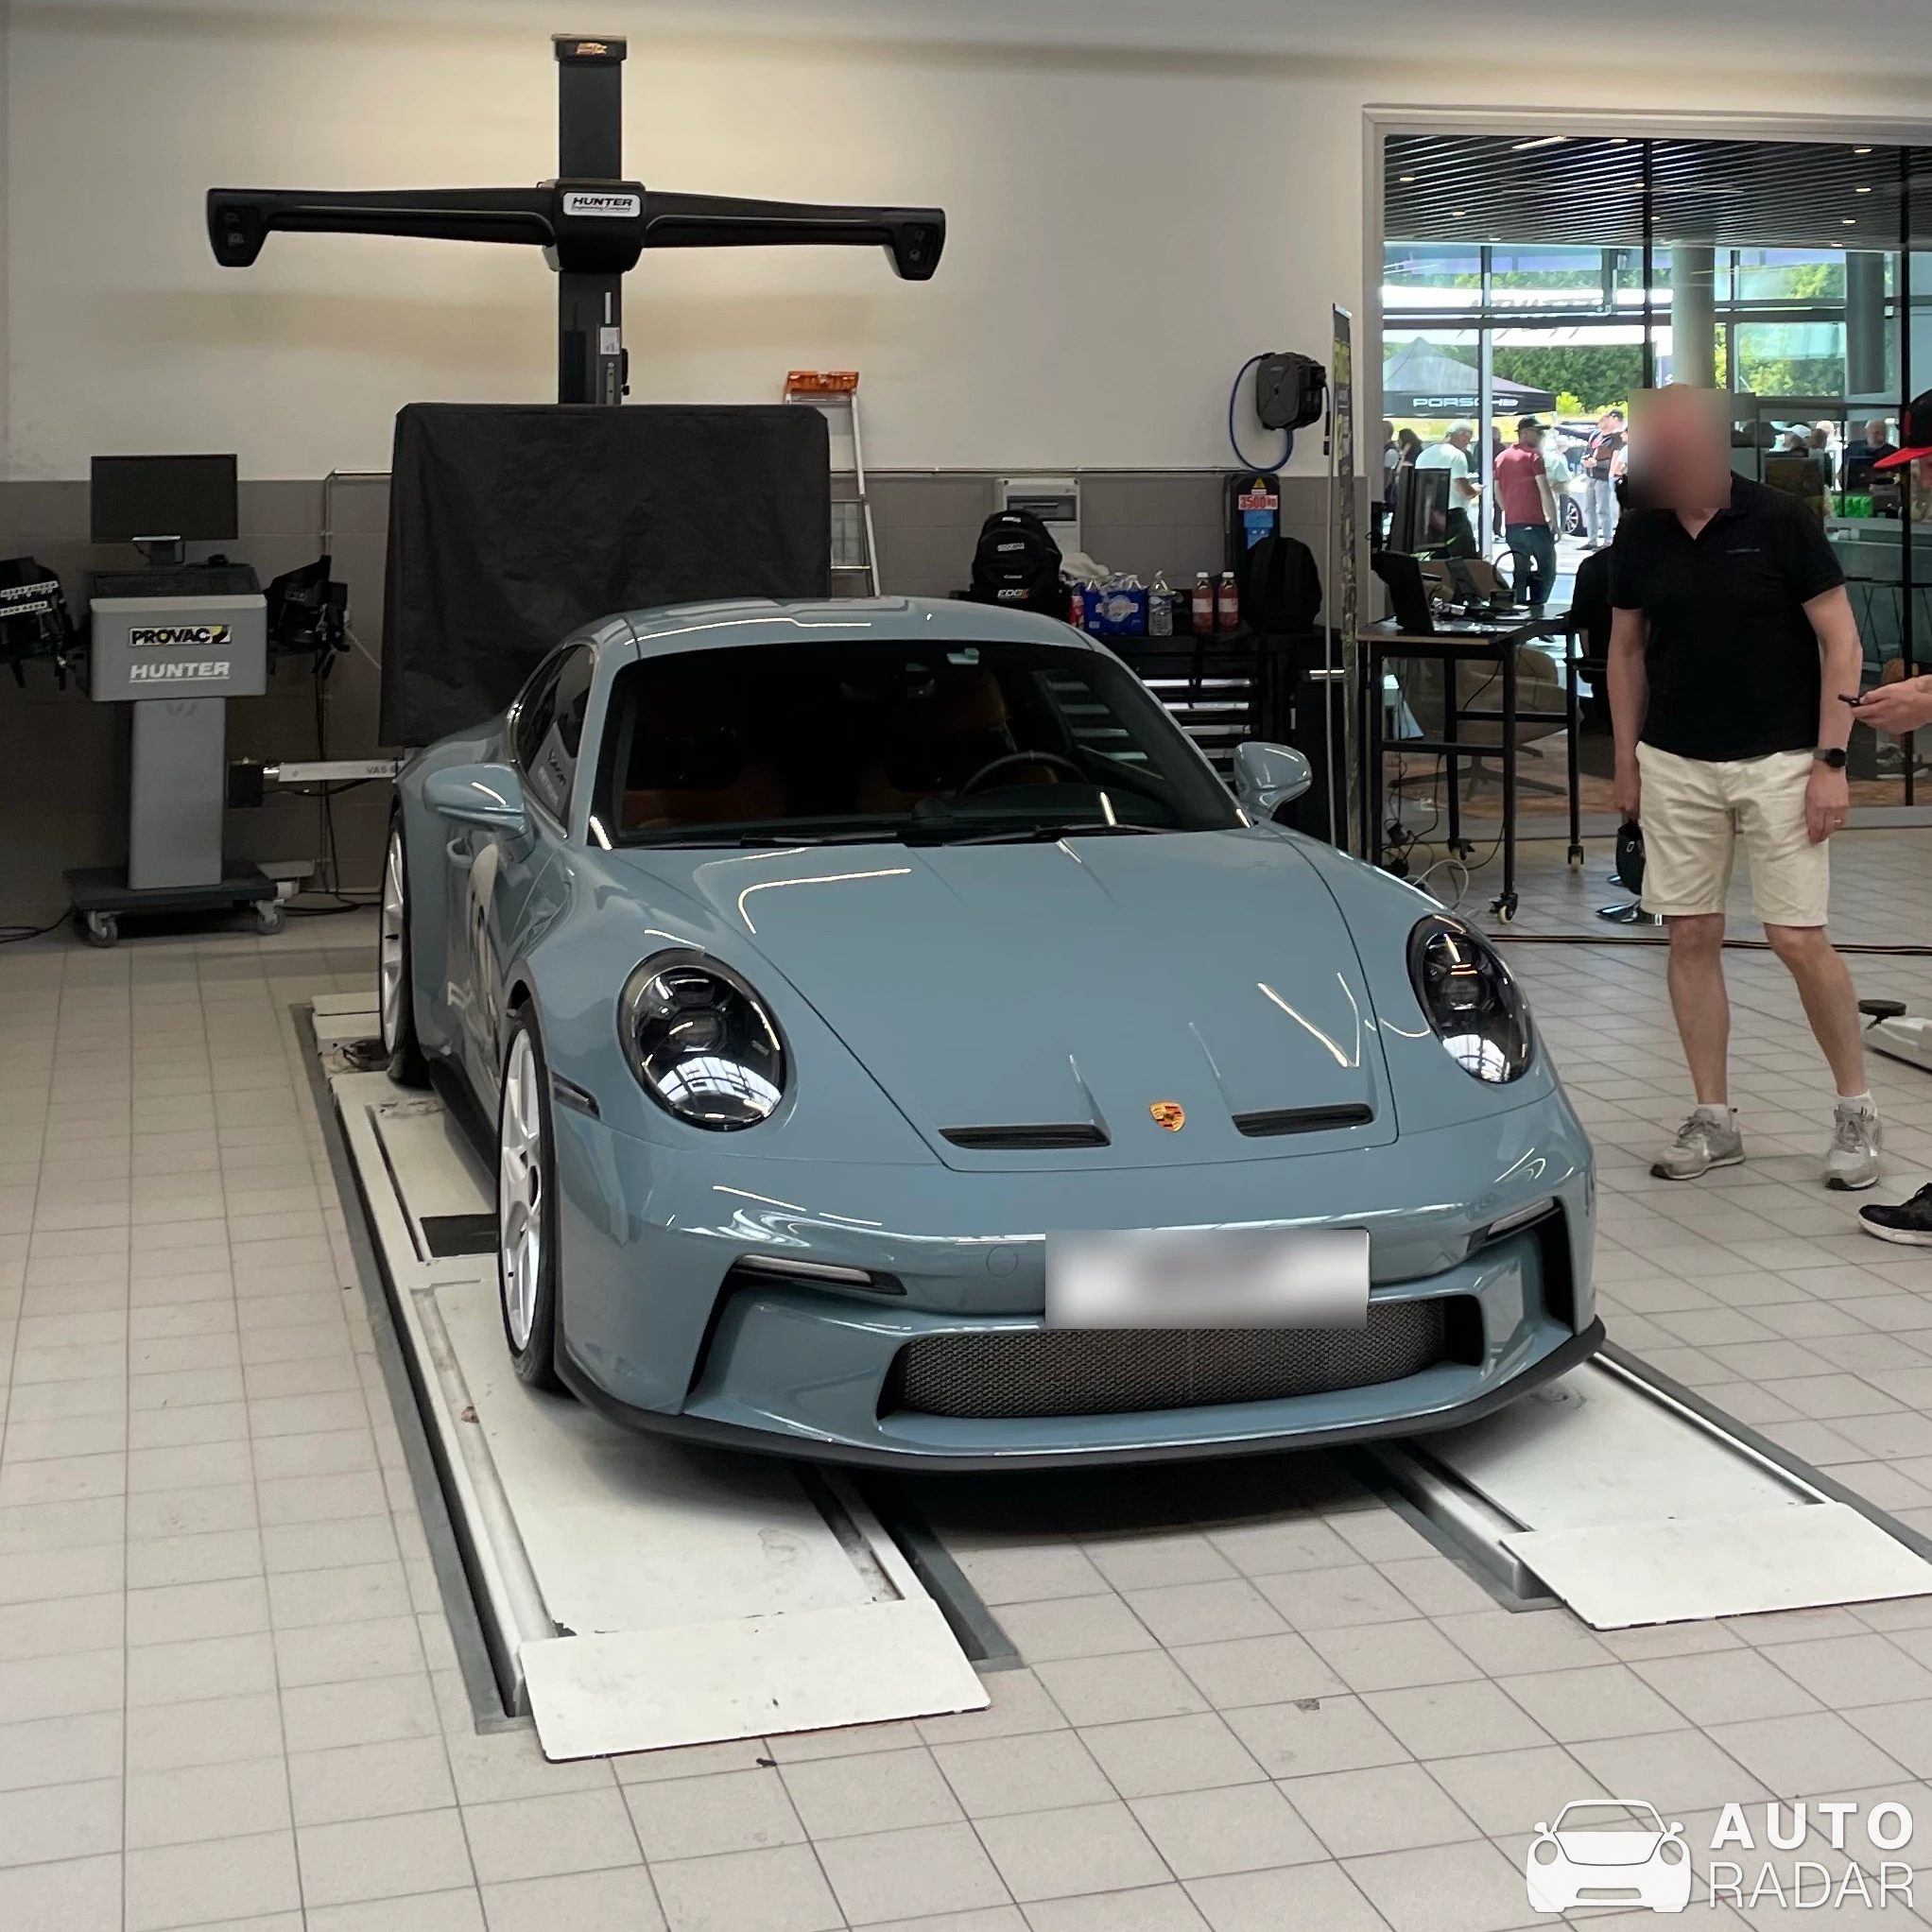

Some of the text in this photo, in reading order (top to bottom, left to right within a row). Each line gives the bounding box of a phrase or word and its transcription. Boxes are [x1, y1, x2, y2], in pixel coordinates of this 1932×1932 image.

[573, 197, 633, 206] HUNTER
[132, 628, 210, 644] PROVAC
[129, 662, 231, 679] HUNTER
